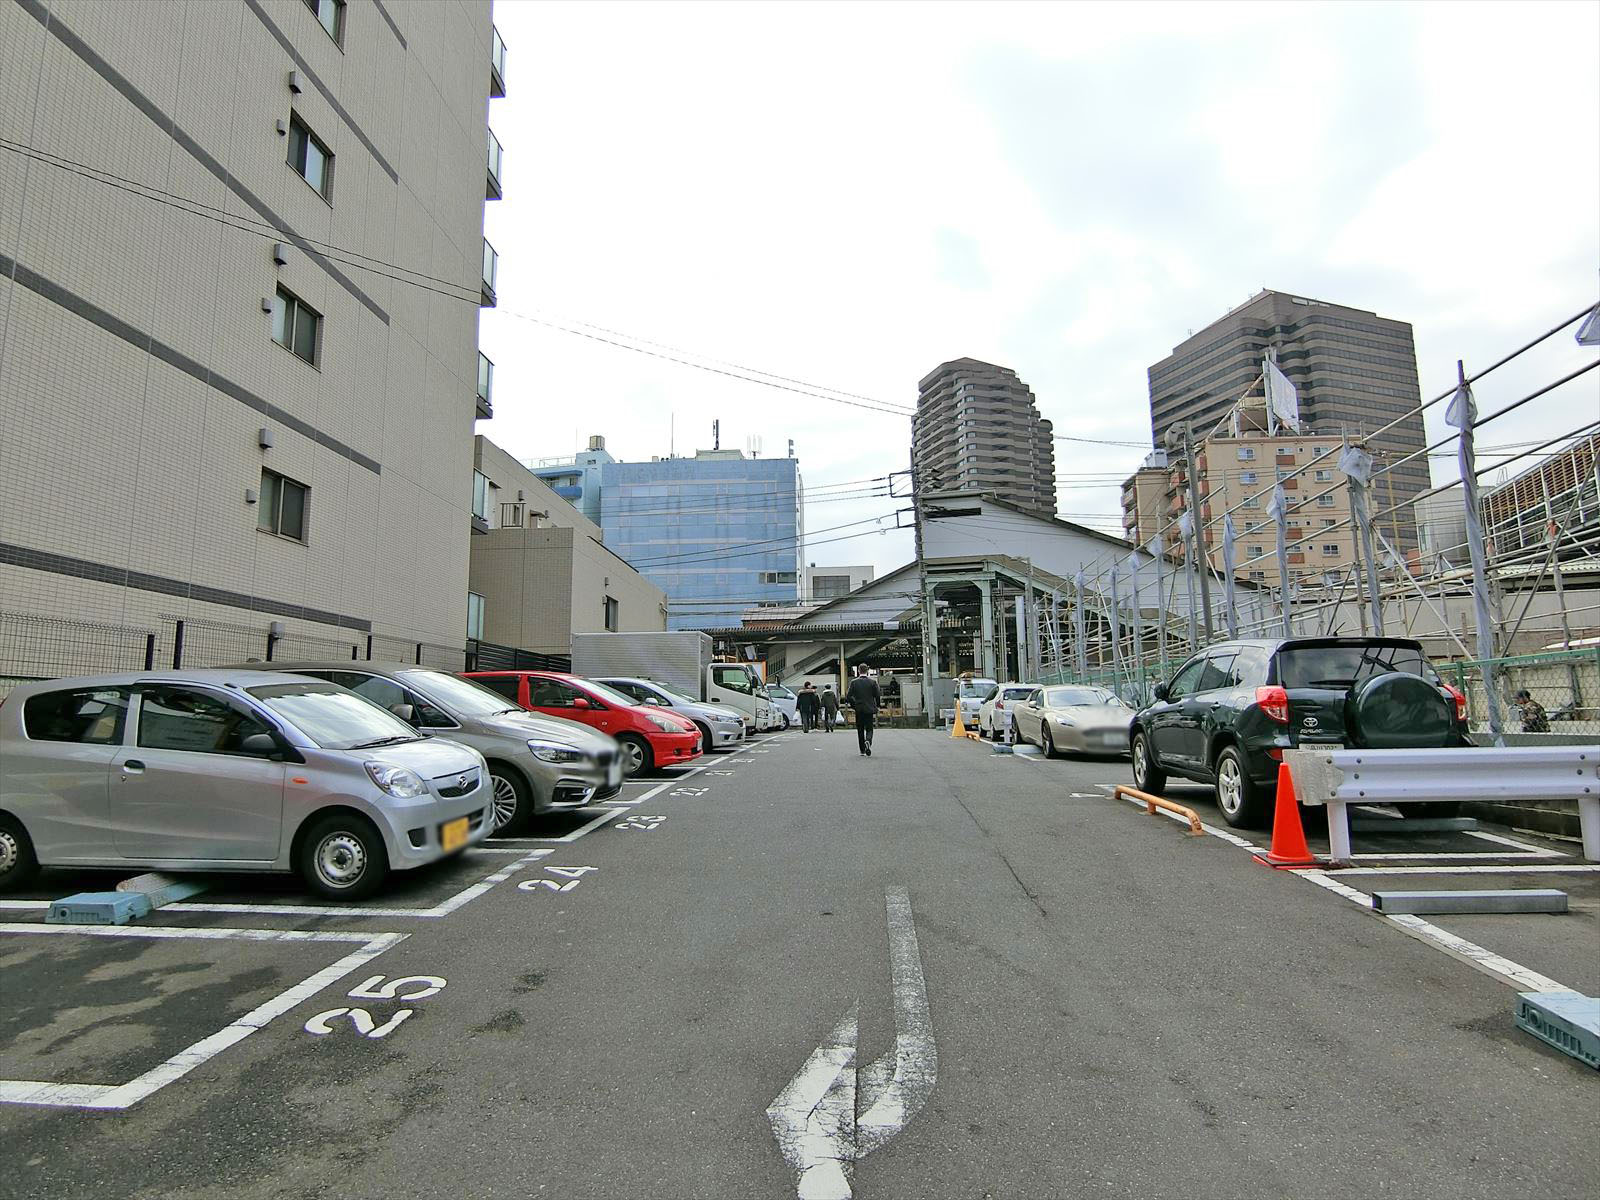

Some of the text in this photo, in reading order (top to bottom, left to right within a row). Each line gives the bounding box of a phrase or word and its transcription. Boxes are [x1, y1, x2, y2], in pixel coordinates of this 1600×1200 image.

[669, 787, 710, 797] 22
[614, 815, 667, 830] 23
[517, 864, 599, 892] 24
[305, 974, 447, 1038] 25
